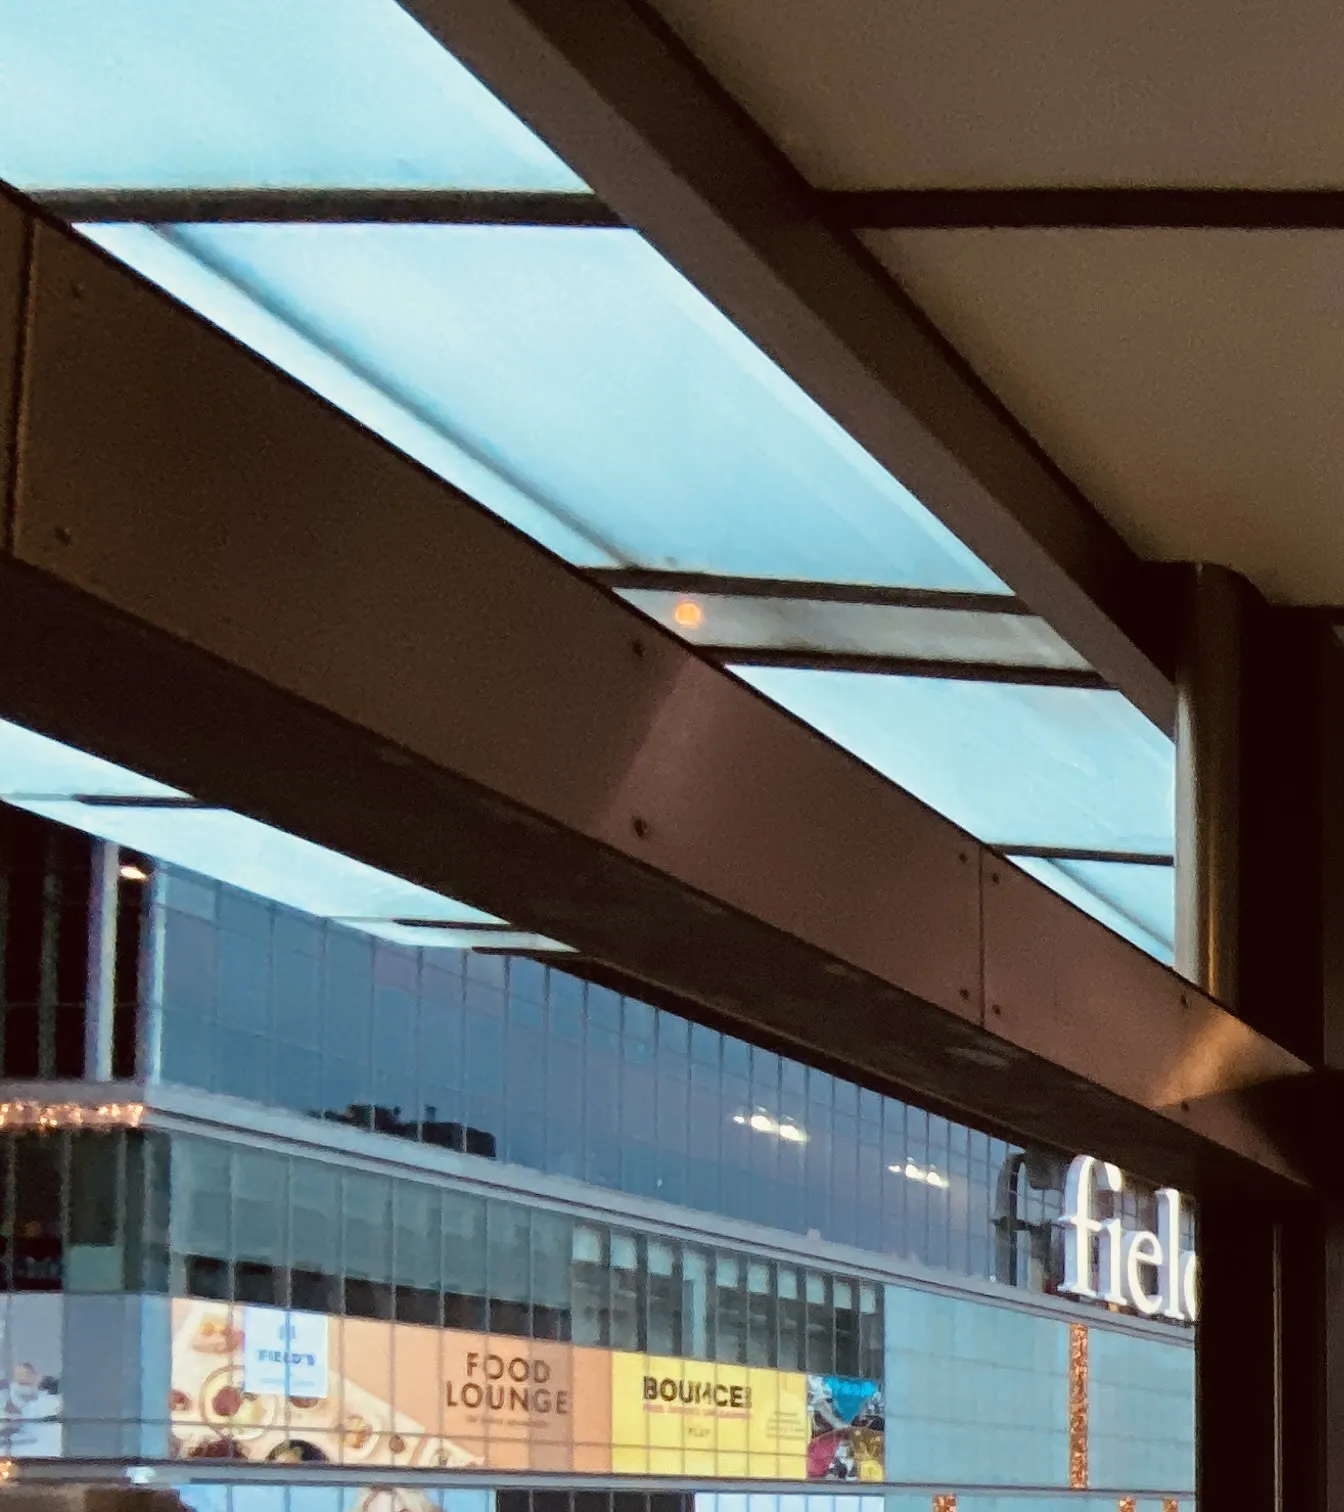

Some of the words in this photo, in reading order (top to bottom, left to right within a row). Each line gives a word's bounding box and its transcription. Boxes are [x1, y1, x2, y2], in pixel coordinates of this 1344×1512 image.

[465, 1352, 552, 1384] FOOD
[446, 1380, 570, 1415] LOUNGE
[643, 1375, 753, 1408] BOUNCE!
